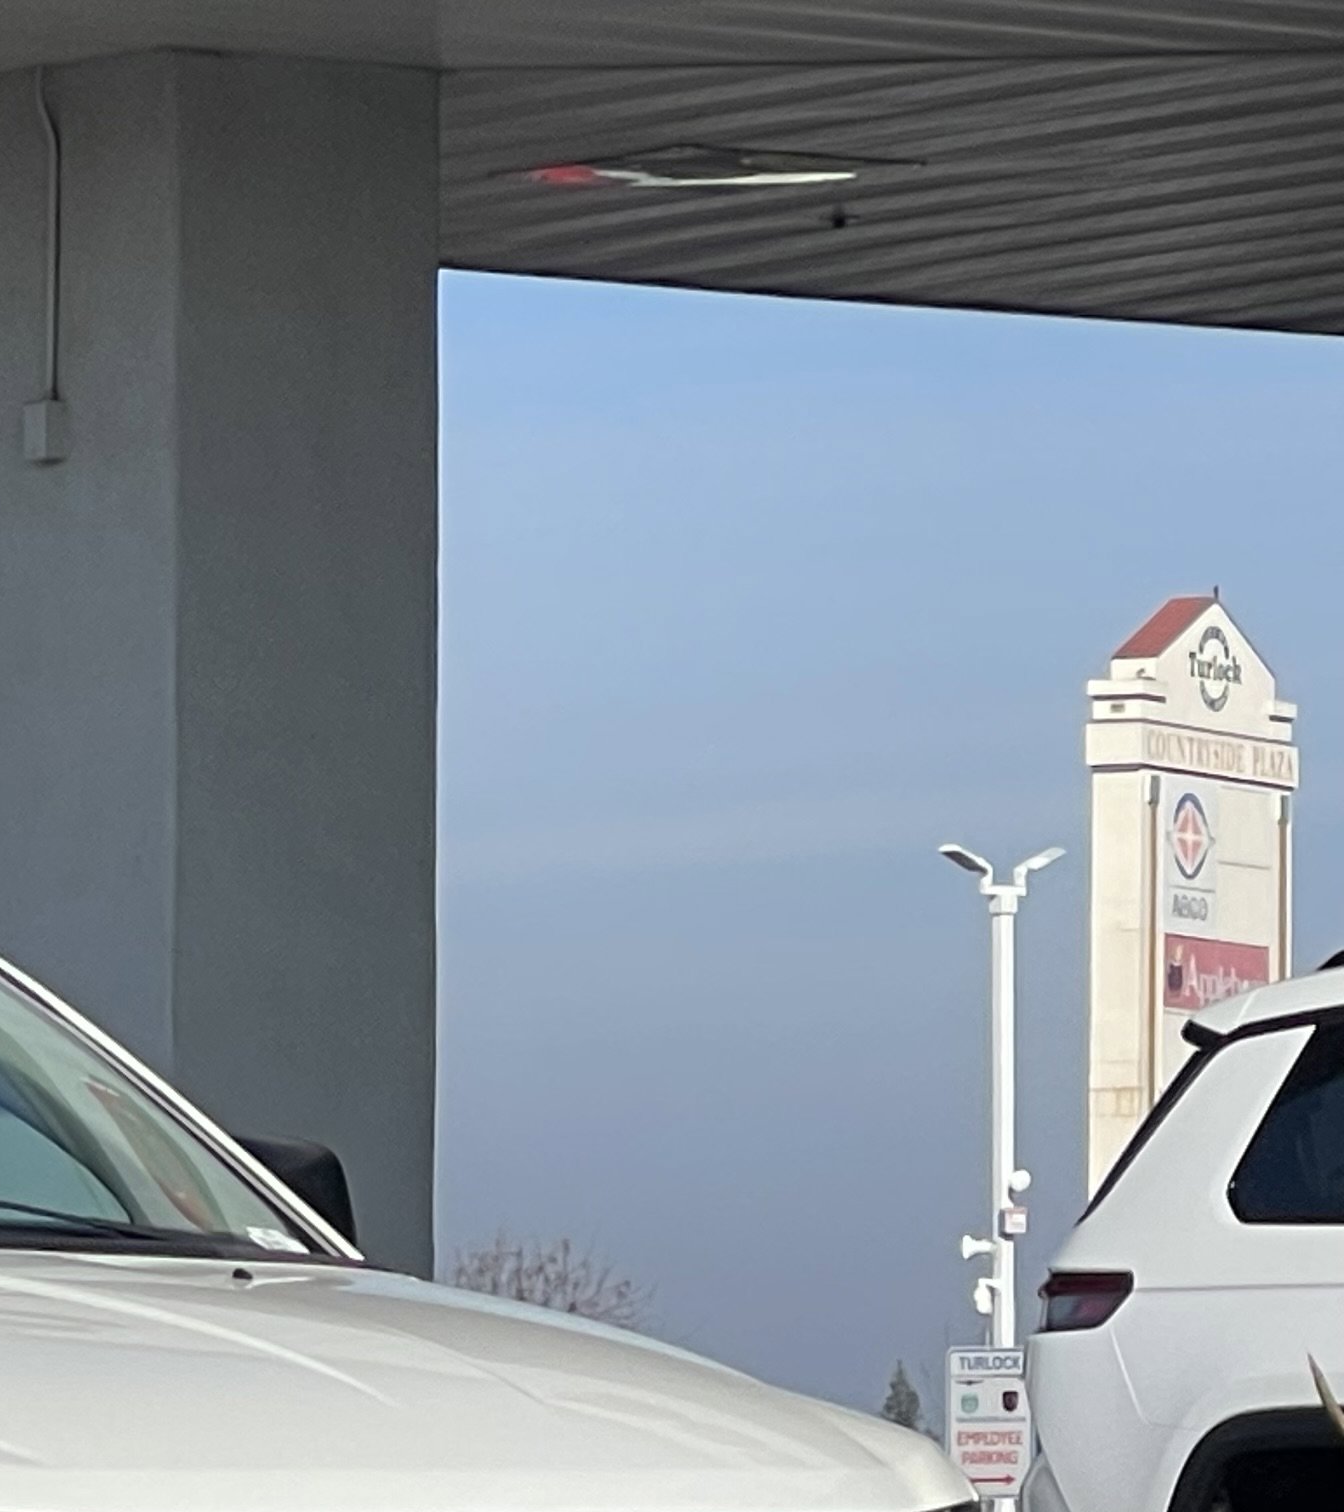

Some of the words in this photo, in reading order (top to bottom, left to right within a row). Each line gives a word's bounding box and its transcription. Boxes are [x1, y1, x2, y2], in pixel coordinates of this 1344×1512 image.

[1189, 652, 1242, 685] Turlock
[1148, 730, 1246, 773] COUNTRYSIDE
[1252, 745, 1295, 781] PLAZA
[959, 1356, 1020, 1370] TURLOCK
[956, 1431, 1023, 1446] EMPLOYEE
[961, 1450, 1018, 1465] PARKING
